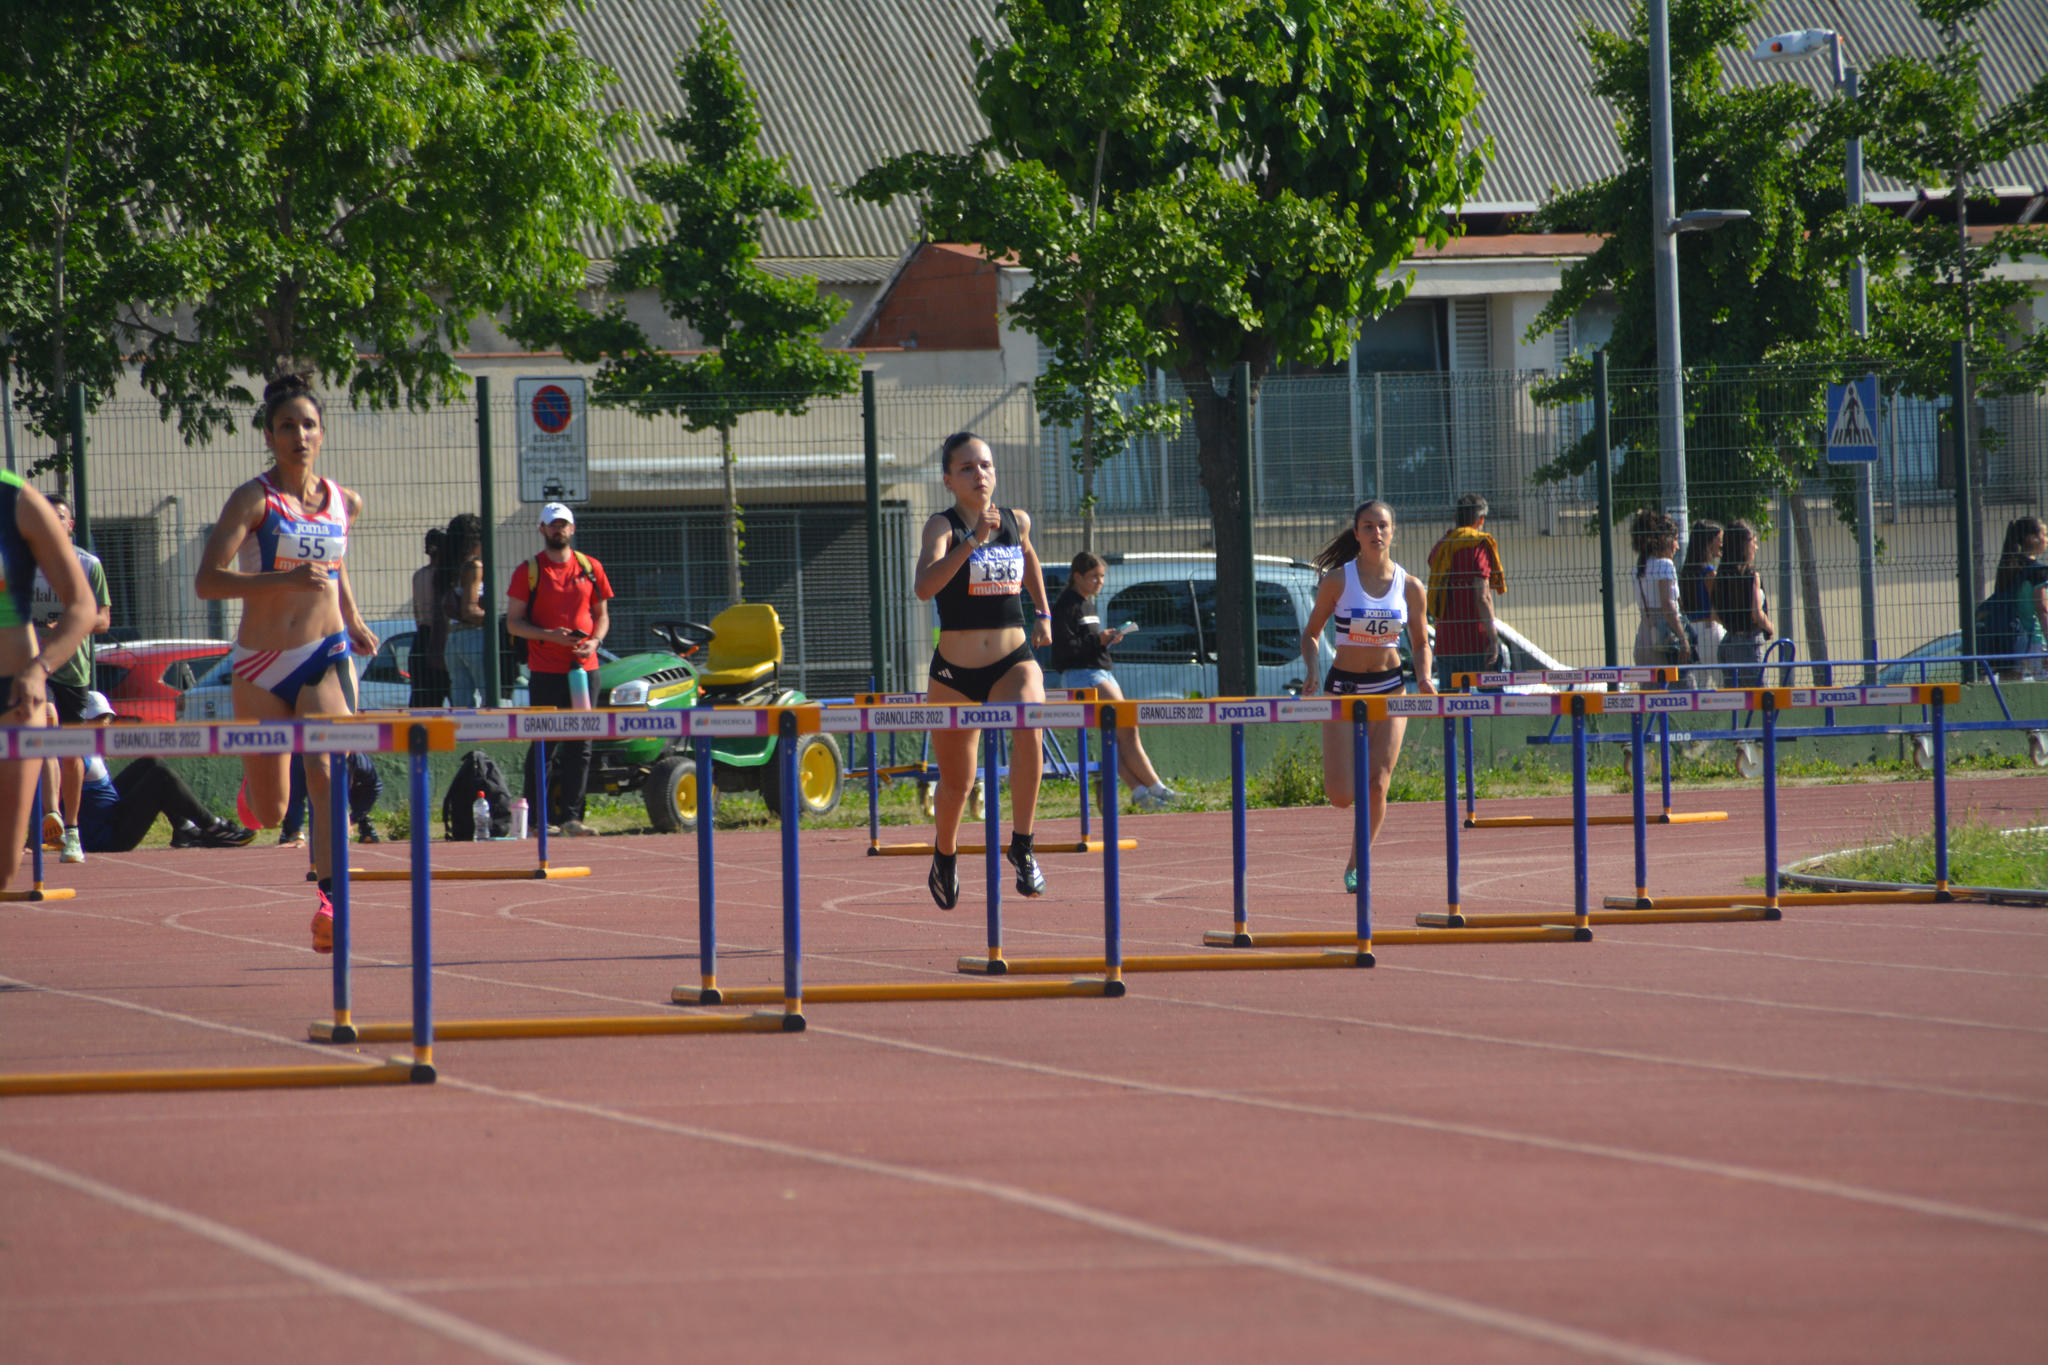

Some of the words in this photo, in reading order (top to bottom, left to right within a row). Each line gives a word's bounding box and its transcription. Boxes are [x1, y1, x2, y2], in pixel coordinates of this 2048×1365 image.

[297, 537, 326, 559] 55
[1365, 620, 1389, 635] 46
[1417, 699, 1433, 711] 2022
[874, 711, 924, 726] GRANOLLERS
[925, 711, 944, 724] 2022
[1140, 706, 1186, 720] GRANOLLERS
[1187, 706, 1204, 719] 2022
[523, 716, 579, 733] GRANOLLERS
[581, 716, 601, 732] 2022
[113, 731, 177, 750] GRANOLLERS
[178, 730, 202, 748] 2022
